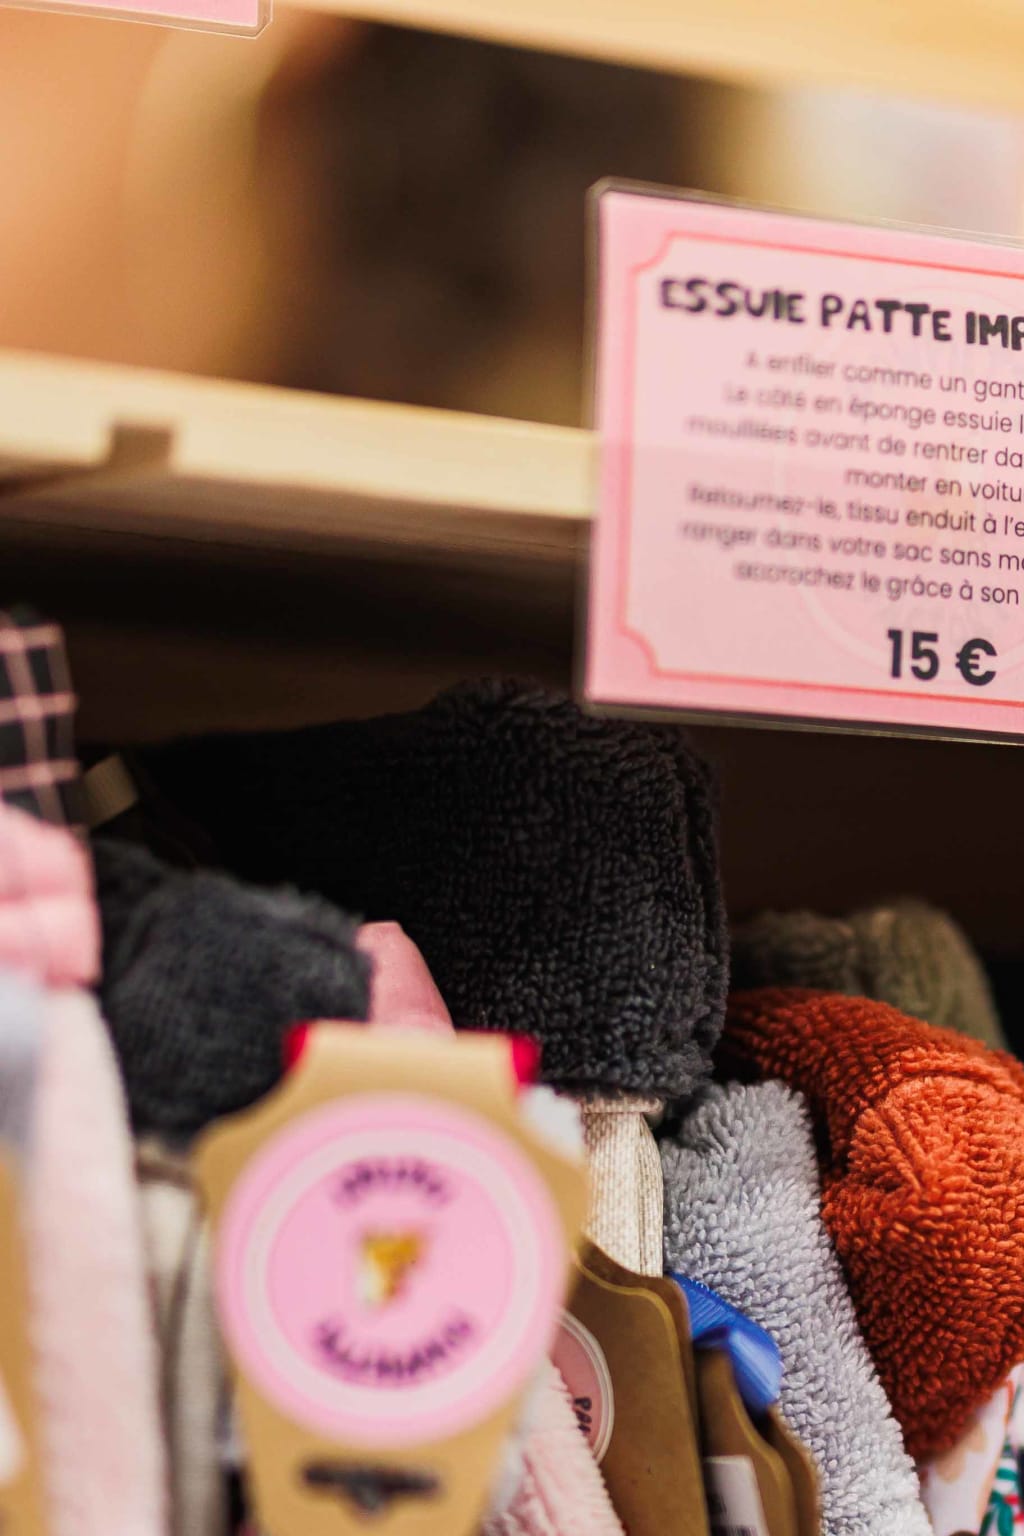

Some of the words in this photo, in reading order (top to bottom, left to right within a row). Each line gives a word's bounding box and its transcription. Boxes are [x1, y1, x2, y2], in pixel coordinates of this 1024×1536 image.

[660, 277, 807, 325] ESSUIE
[819, 293, 952, 341] PATTE
[841, 366, 934, 391] comme
[939, 376, 967, 394] un
[973, 380, 1024, 402] gant
[724, 386, 750, 402] Le
[815, 399, 843, 414] en
[849, 394, 938, 429] éponge
[943, 410, 1013, 433] essuie
[685, 415, 798, 443] mouillées
[803, 429, 870, 452] avant
[877, 435, 907, 456] de
[914, 440, 989, 466] rentrer
[845, 468, 928, 493] monter
[935, 477, 963, 497] en
[846, 500, 900, 525] tissu
[906, 508, 978, 532] enduit
[983, 513, 998, 534] à
[679, 519, 758, 549] ranger
[764, 526, 823, 551] dans
[828, 535, 888, 560] votre
[893, 544, 933, 563] sac
[939, 547, 992, 570] sans
[735, 562, 857, 592] accrochez
[862, 570, 881, 593] le
[886, 573, 955, 602] grâce
[959, 580, 974, 601] à
[980, 584, 1020, 606] son
[887, 628, 940, 681] 15
[955, 637, 998, 687] €
